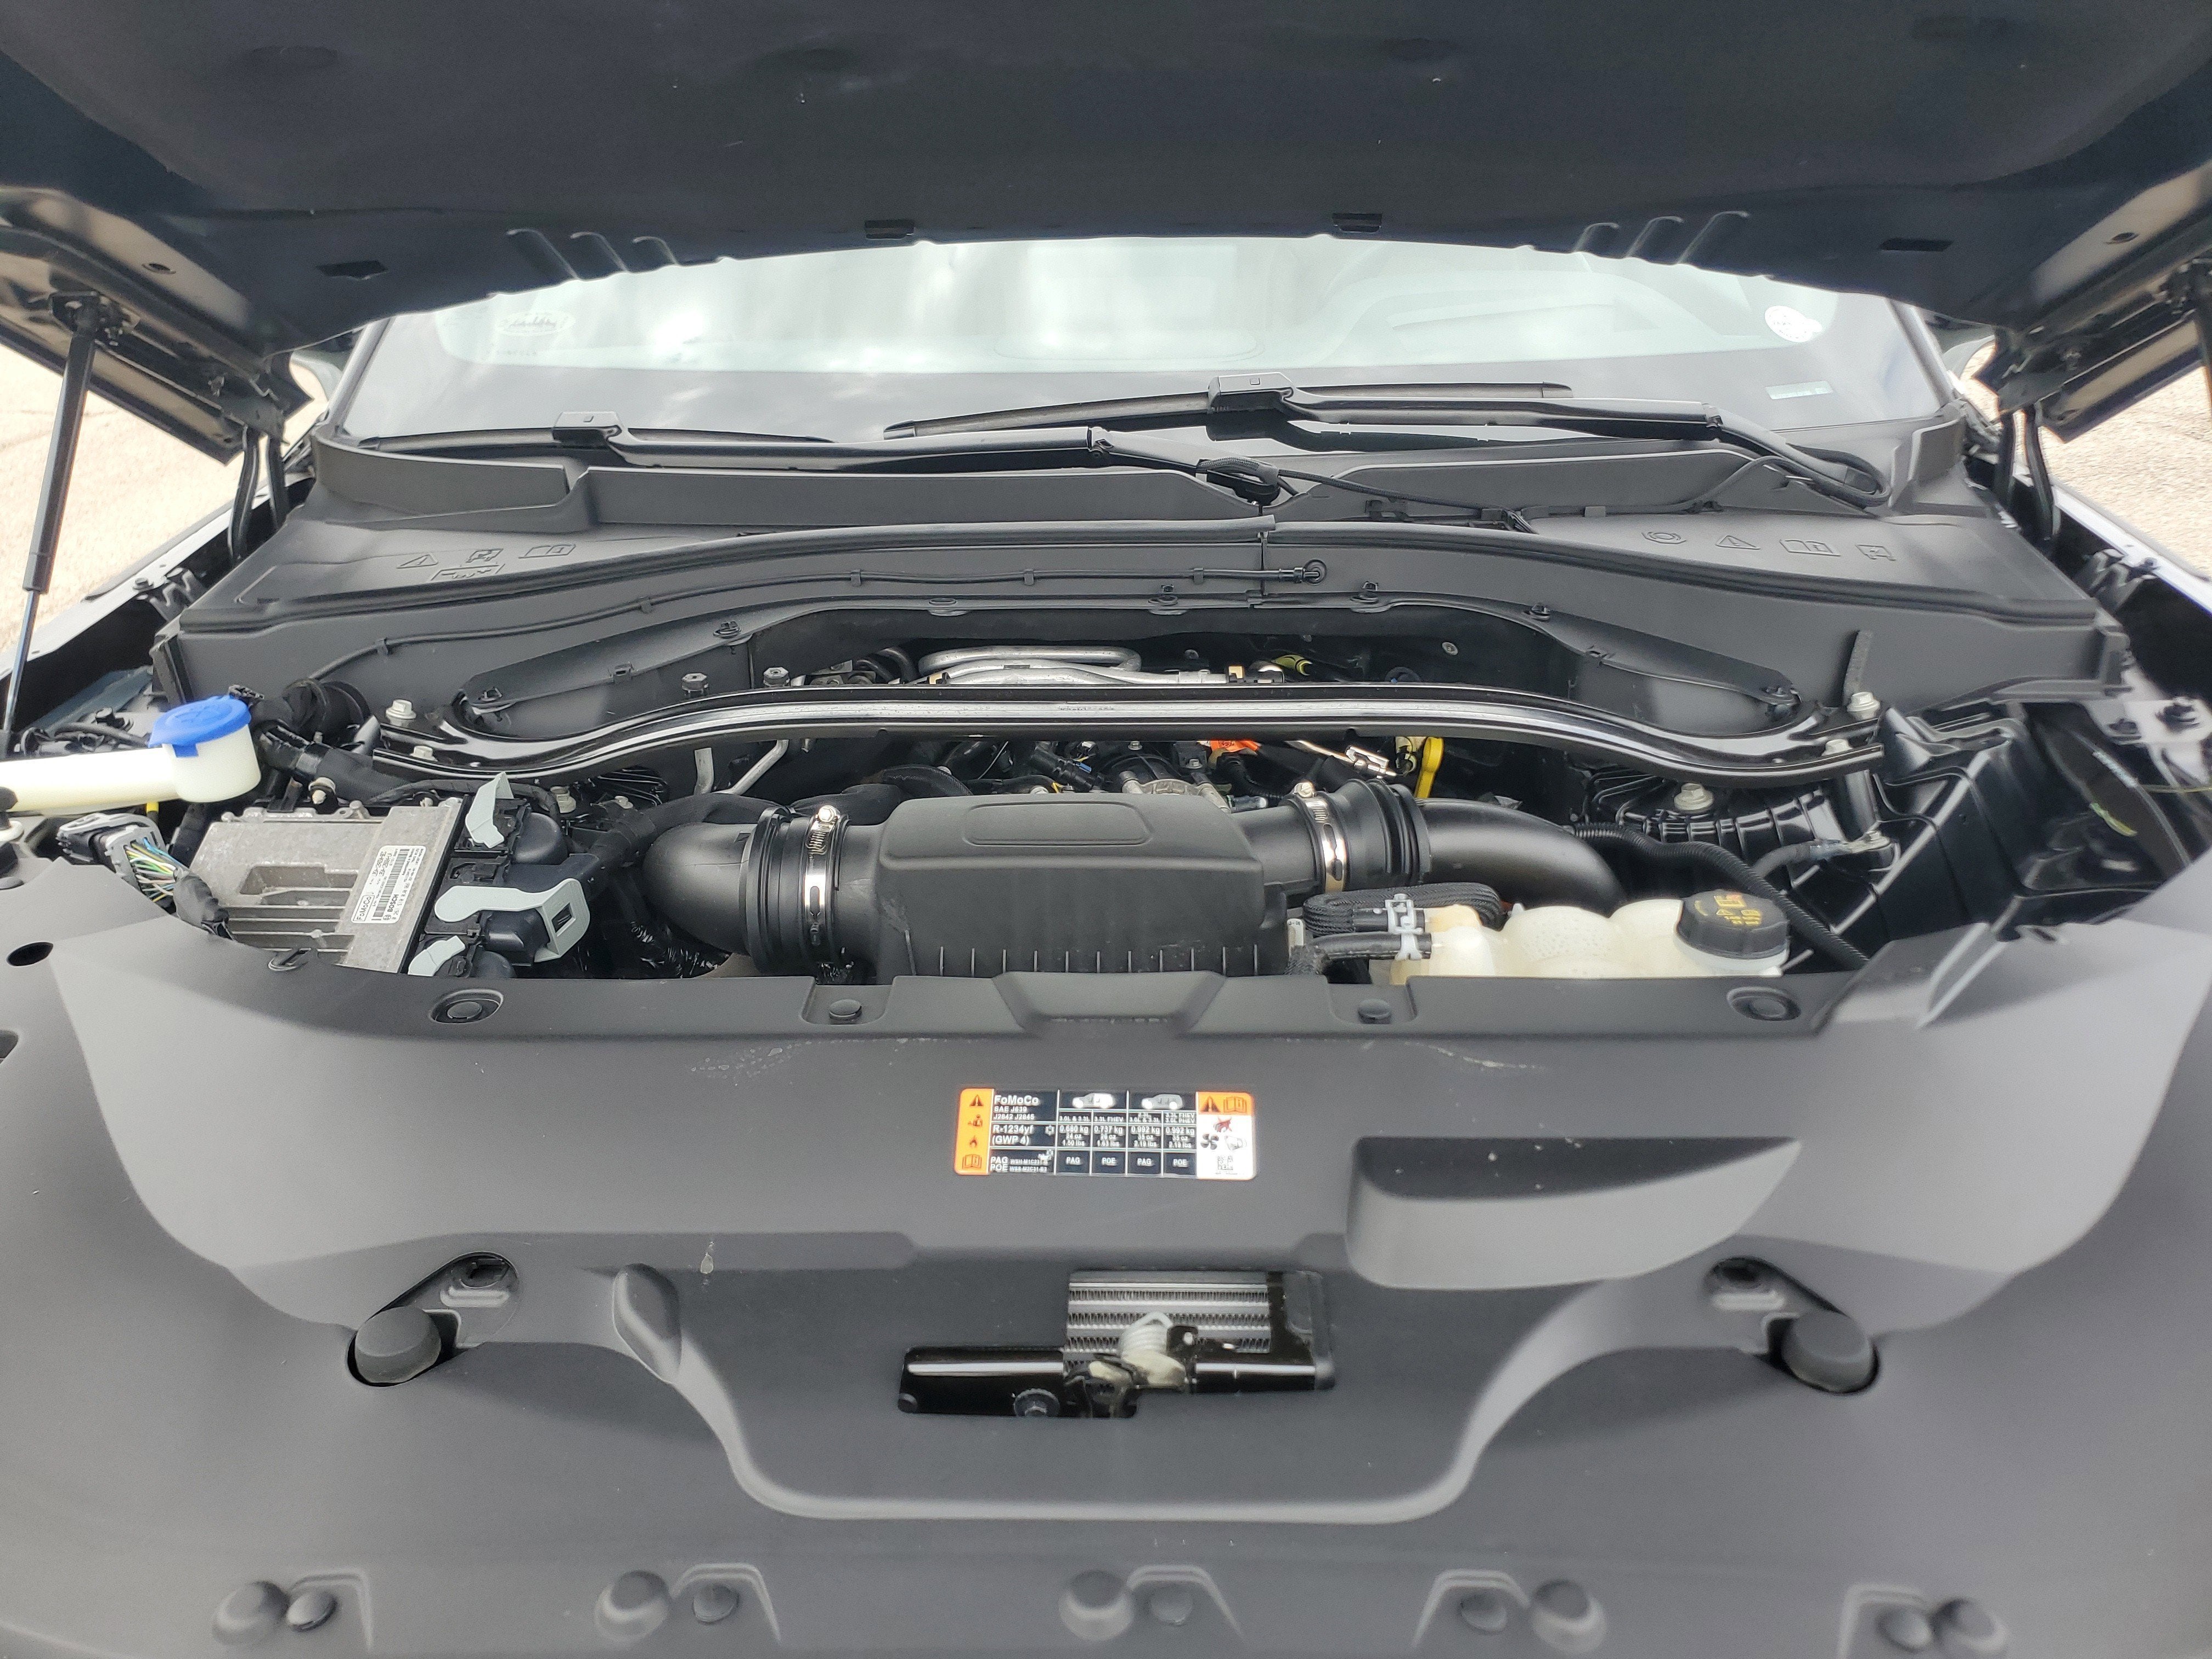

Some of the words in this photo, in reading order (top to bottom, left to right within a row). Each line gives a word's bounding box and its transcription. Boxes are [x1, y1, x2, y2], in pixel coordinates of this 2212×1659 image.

[357, 896, 371, 920] FoMoCo
[387, 894, 399, 912] BOSCH
[994, 1095, 1040, 1105] FoMoCo
[992, 1125, 1034, 1135] R-1234yf
[1080, 1125, 1089, 1135] kg
[1114, 1126, 1123, 1135] kg
[1151, 1126, 1160, 1135] kg
[1186, 1127, 1195, 1136] kg
[992, 1135, 1019, 1146] (GWP
[1020, 1135, 1030, 1146] 4)
